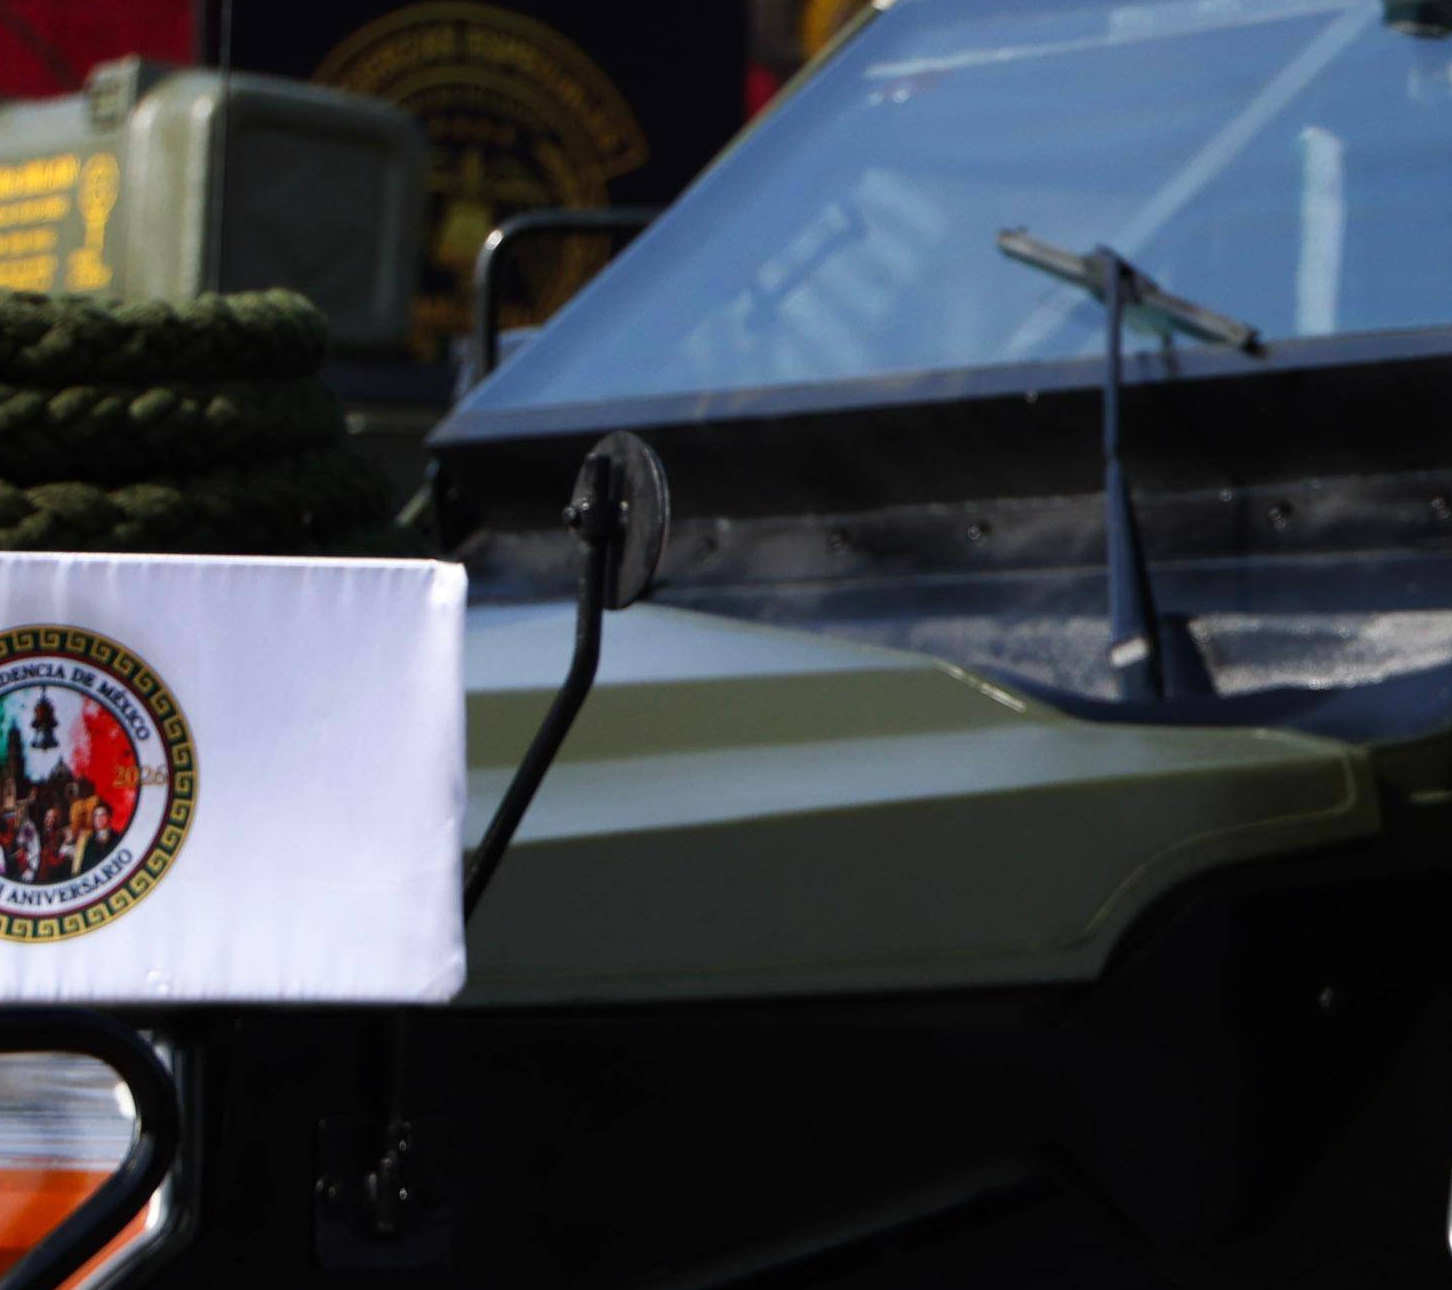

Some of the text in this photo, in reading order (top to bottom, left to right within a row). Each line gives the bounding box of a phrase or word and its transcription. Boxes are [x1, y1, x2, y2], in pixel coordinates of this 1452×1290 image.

[71, 666, 96, 687] DE
[98, 681, 150, 741] MÉXICO
[7, 848, 133, 906] ANIVERSARIO
